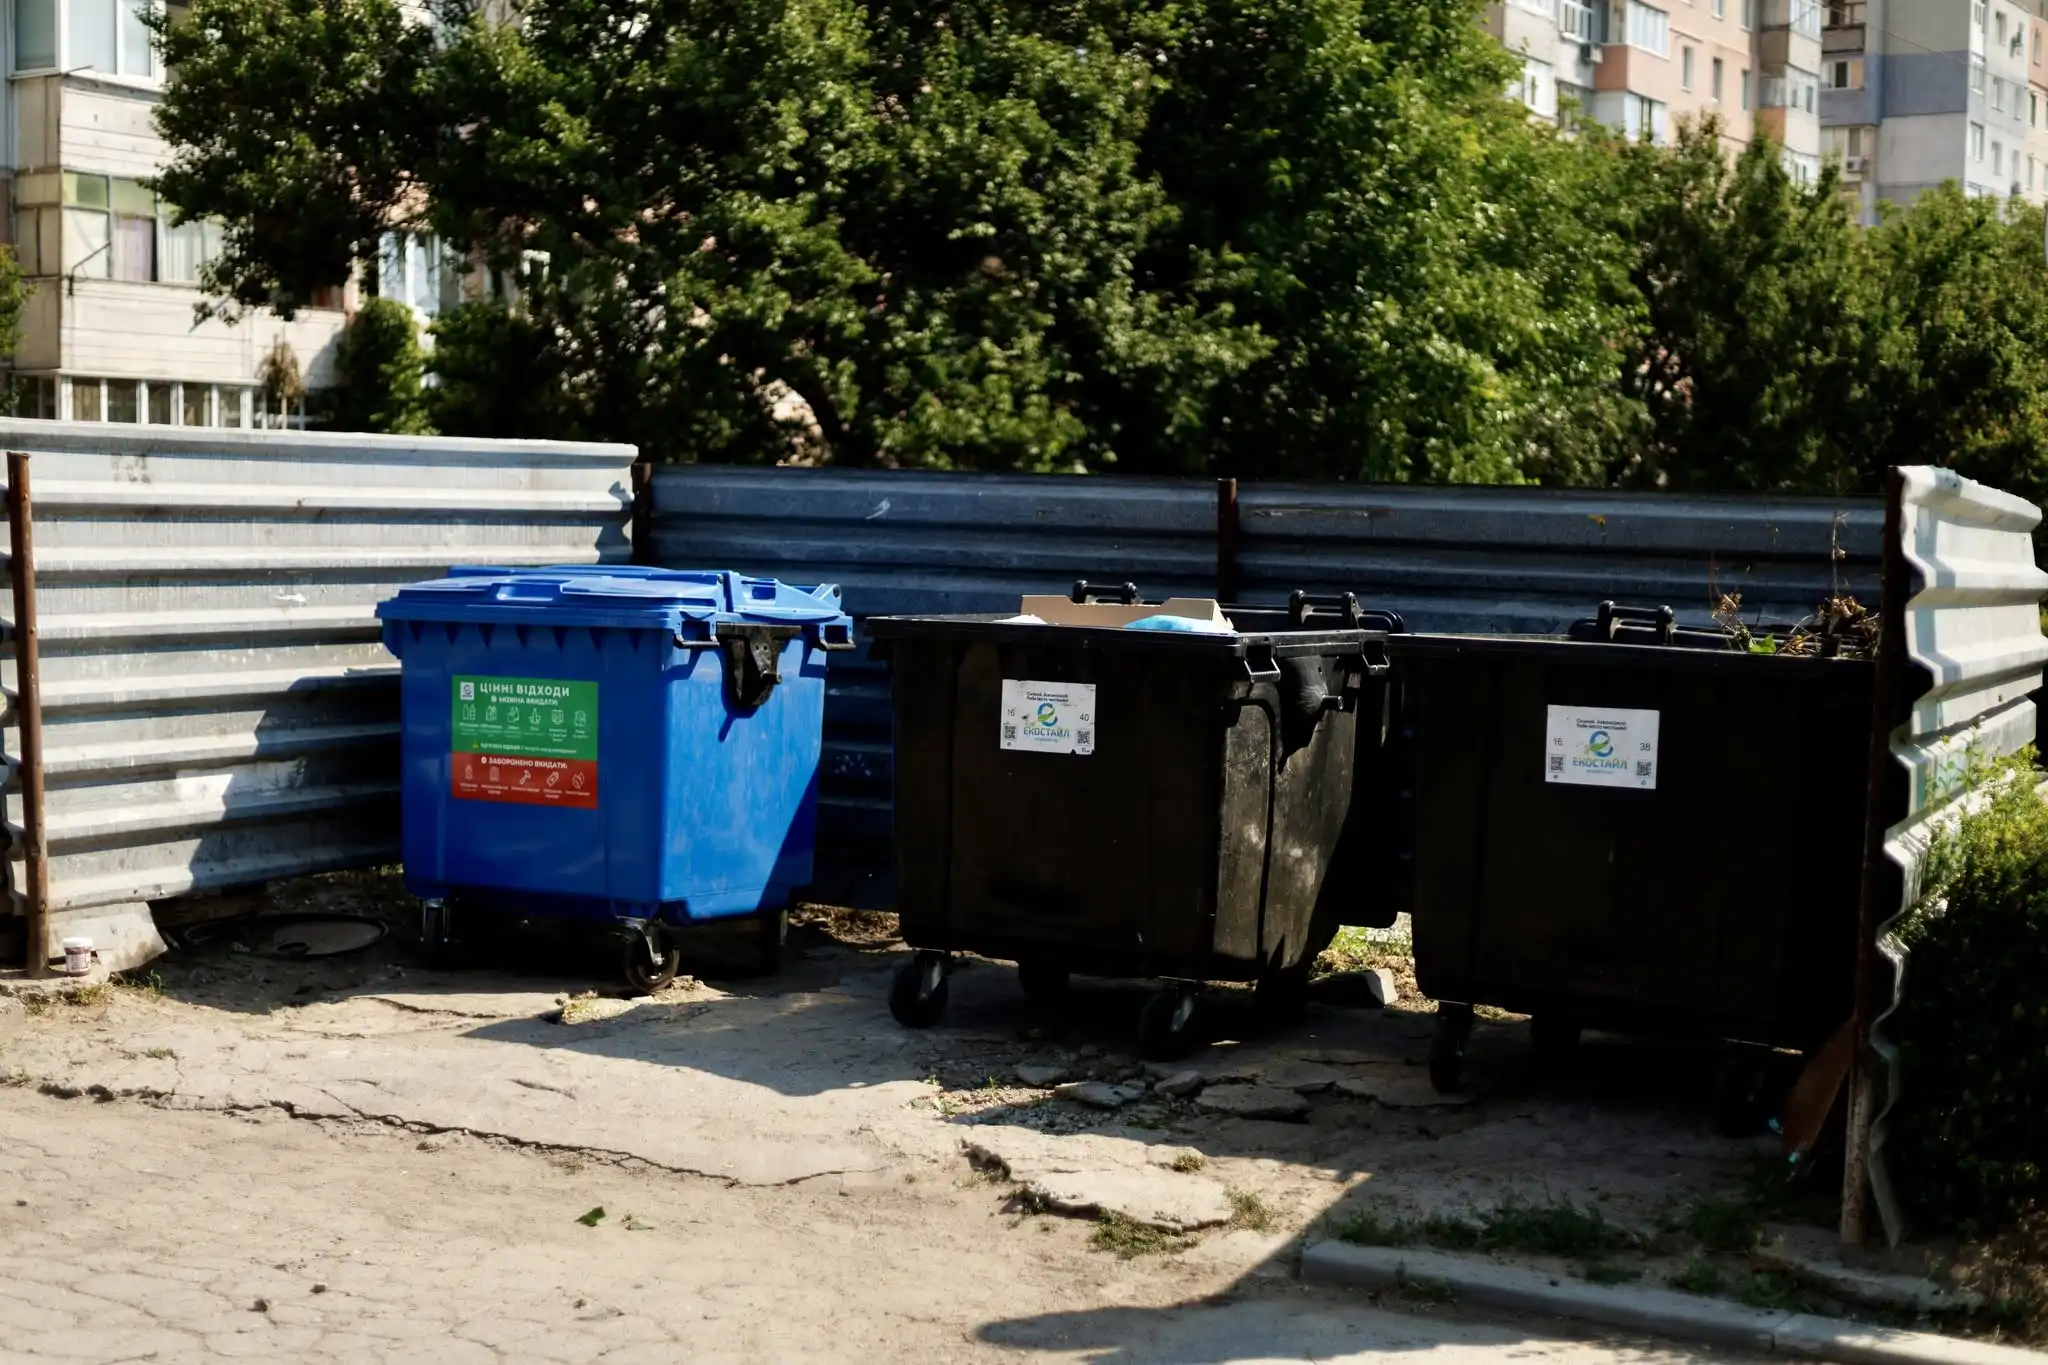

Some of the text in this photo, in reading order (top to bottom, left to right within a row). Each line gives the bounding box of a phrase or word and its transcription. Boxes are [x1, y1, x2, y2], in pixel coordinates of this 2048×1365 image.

[479, 682, 570, 697] ЦІННІ ВІДХОДИ
[1007, 708, 1015, 717] 16
[1079, 713, 1089, 722] 40
[1023, 726, 1070, 738] ЕКОСТАЙЛ
[1553, 737, 1563, 746] 16
[1639, 742, 1651, 752] 38
[488, 757, 534, 767] ЗАБОРОНЕНО
[1572, 756, 1628, 770] ЕКОСТАЙЛ
